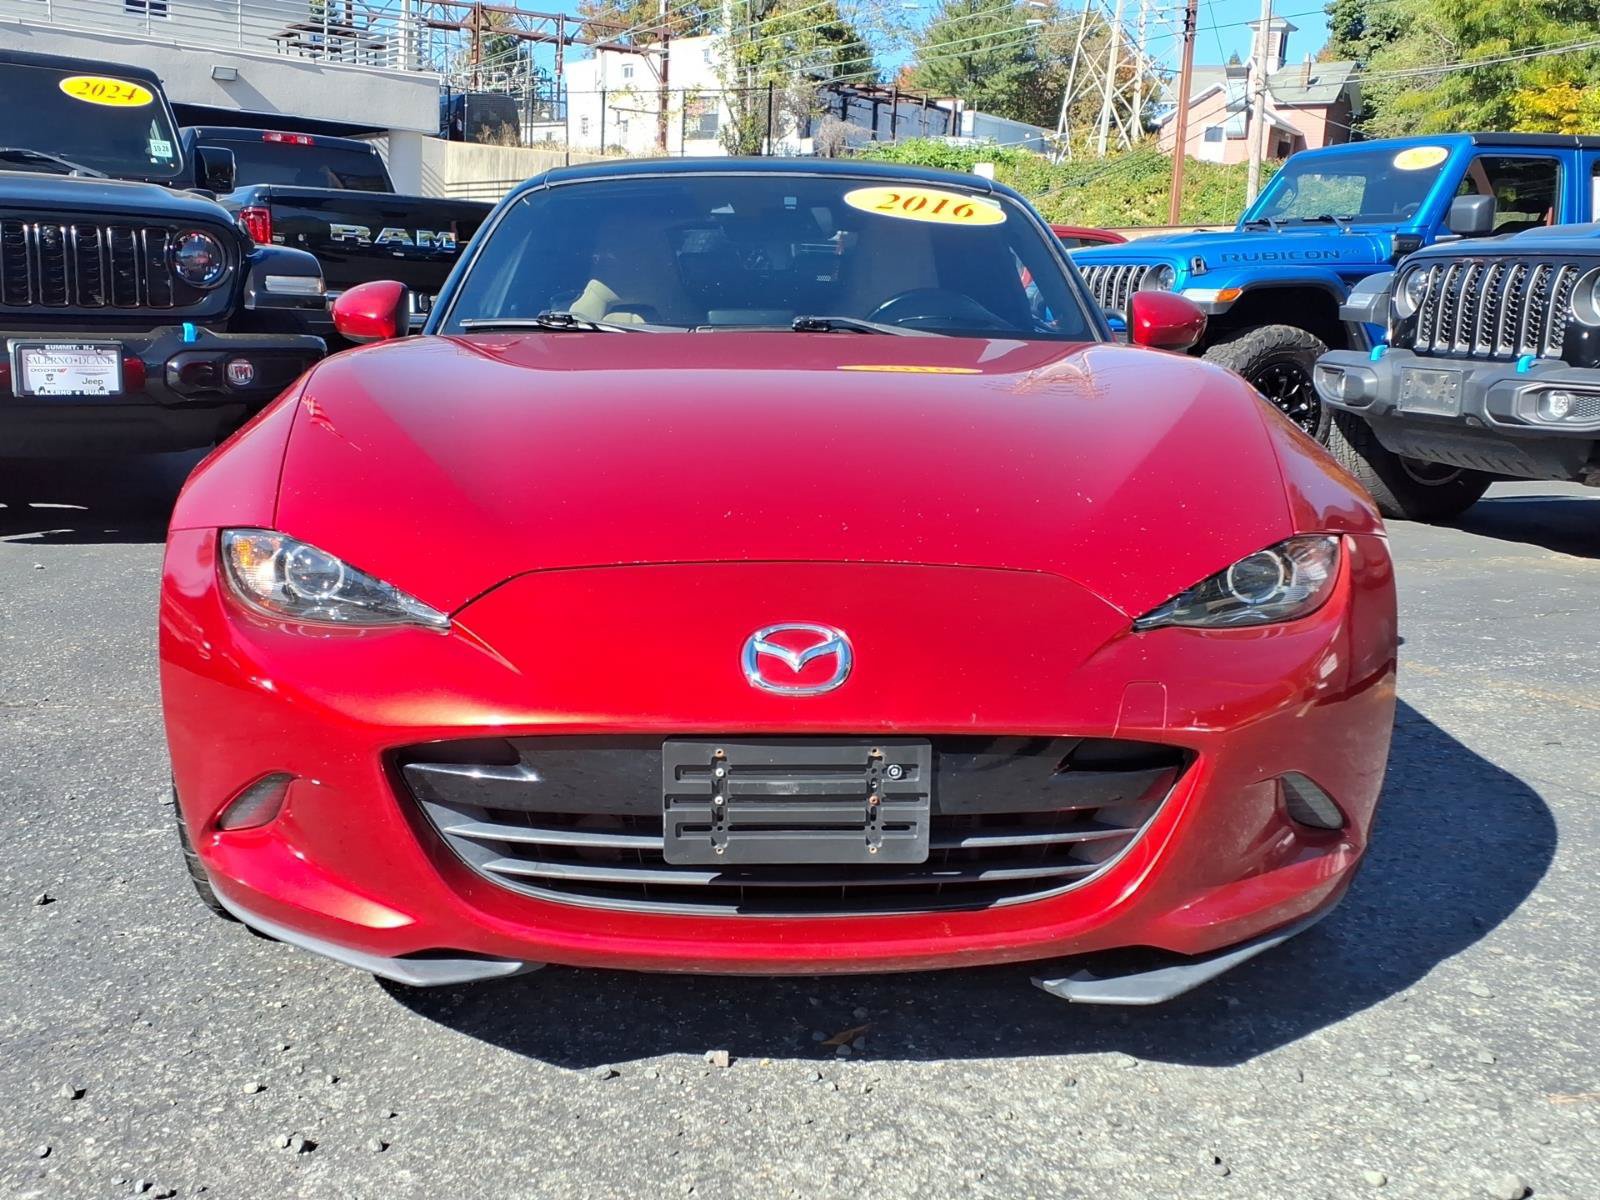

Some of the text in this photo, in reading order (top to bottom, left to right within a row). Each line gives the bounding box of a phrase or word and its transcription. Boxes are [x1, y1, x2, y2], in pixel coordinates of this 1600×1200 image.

[76, 81, 138, 100] 2024
[876, 193, 977, 218] 2016
[330, 223, 456, 249] RAM
[1220, 249, 1340, 263] RUBICON
[25, 355, 116, 365] SALERNO DUANE
[82, 377, 104, 386] Jeep
